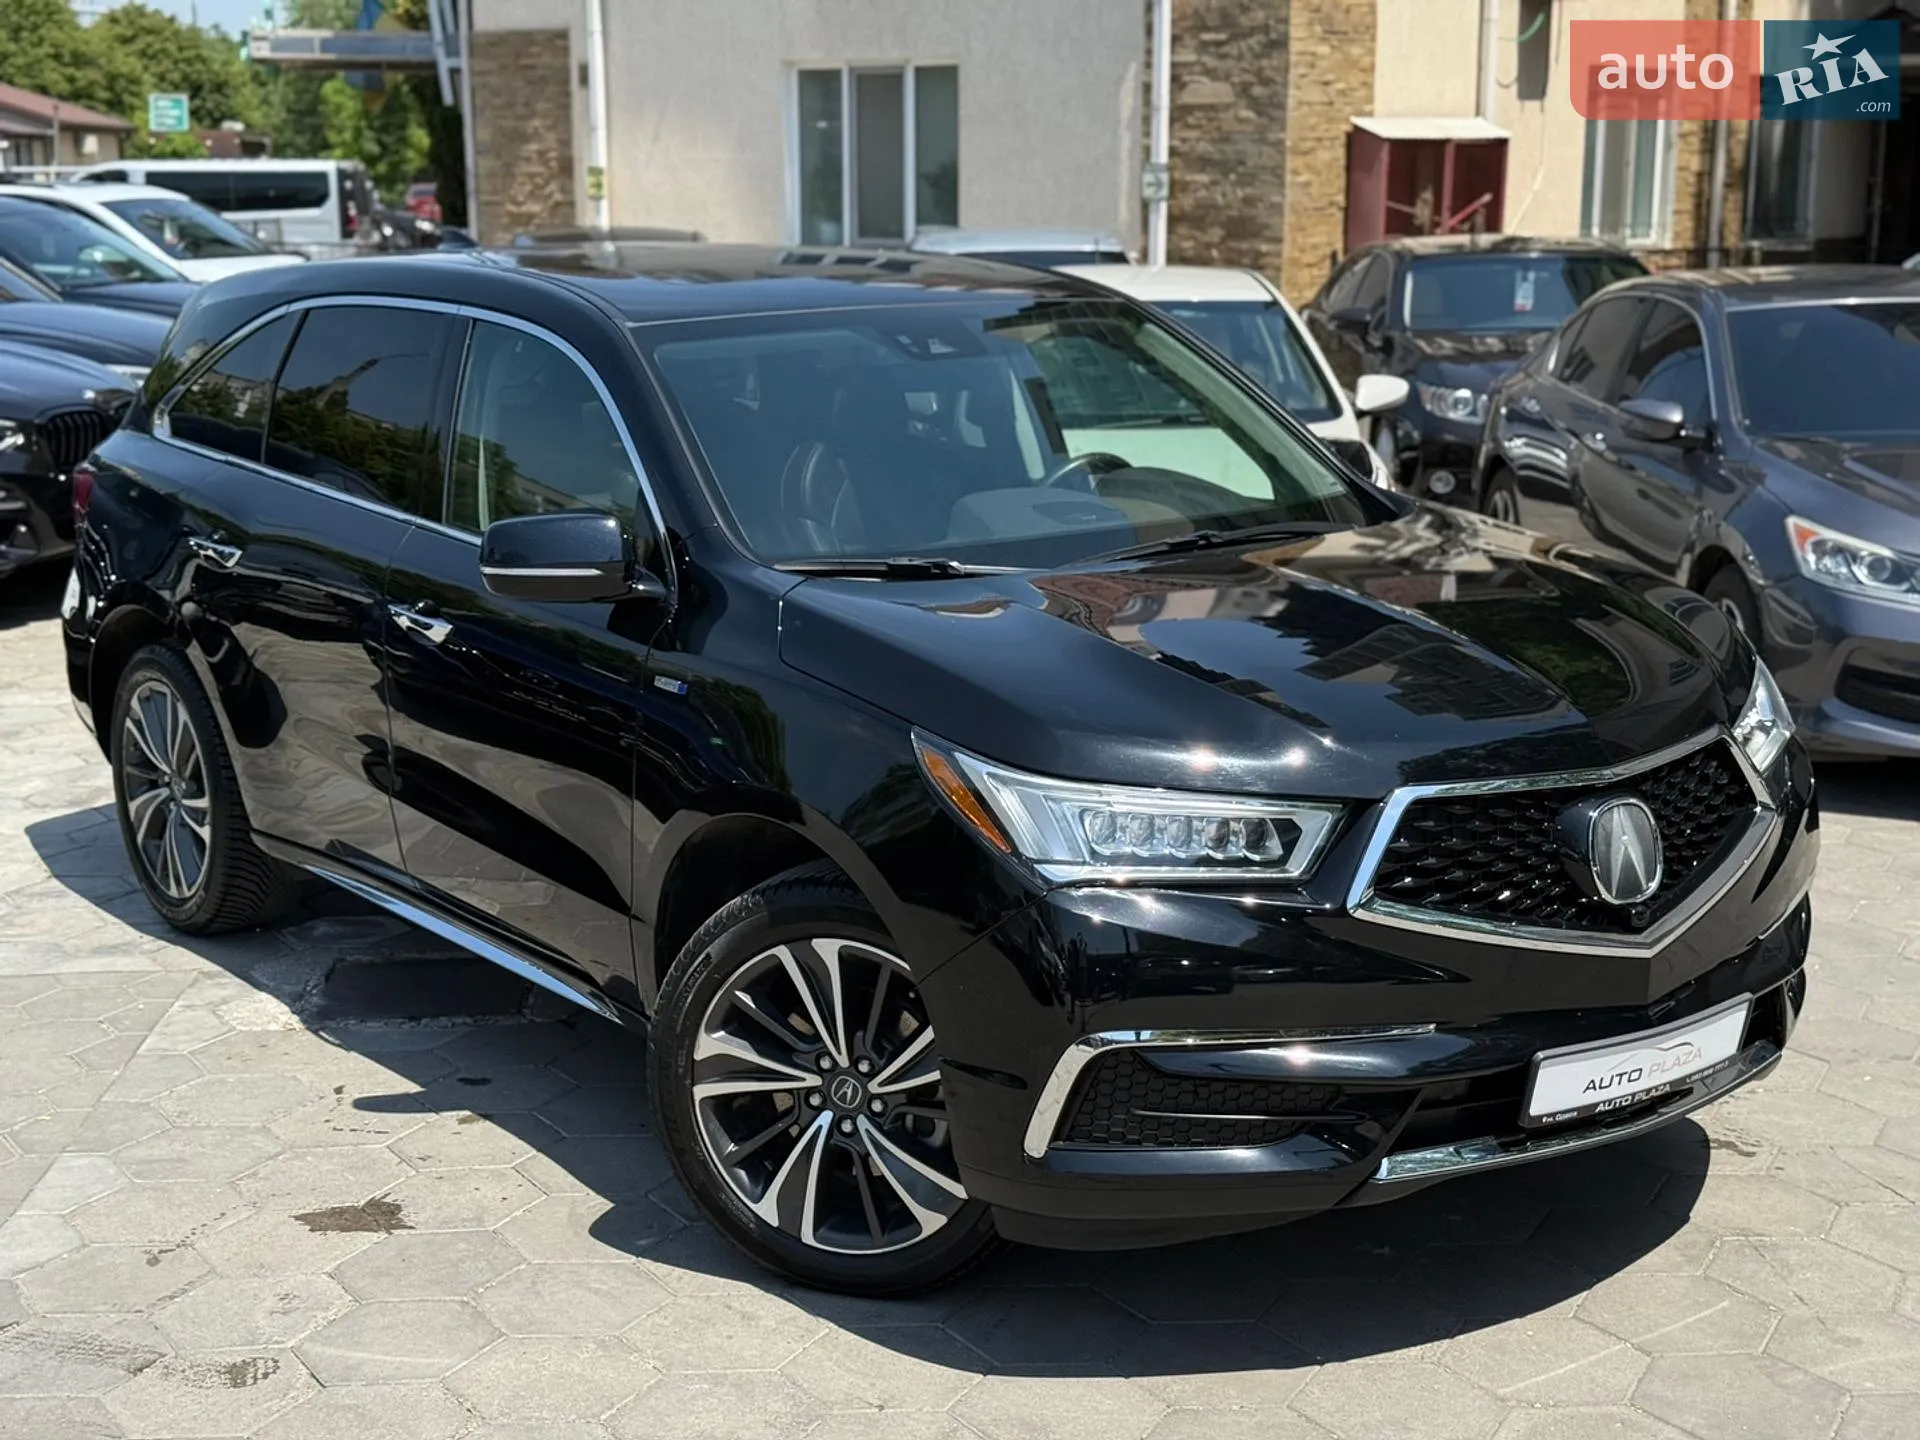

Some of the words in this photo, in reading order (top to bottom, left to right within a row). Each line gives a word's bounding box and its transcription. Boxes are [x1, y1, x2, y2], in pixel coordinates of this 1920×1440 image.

[1582, 1067, 1643, 1094] AUTO
[1647, 1048, 1702, 1078] PLAZA
[1595, 1094, 1632, 1113] AUTO
[1634, 1084, 1671, 1103] PLAZA
